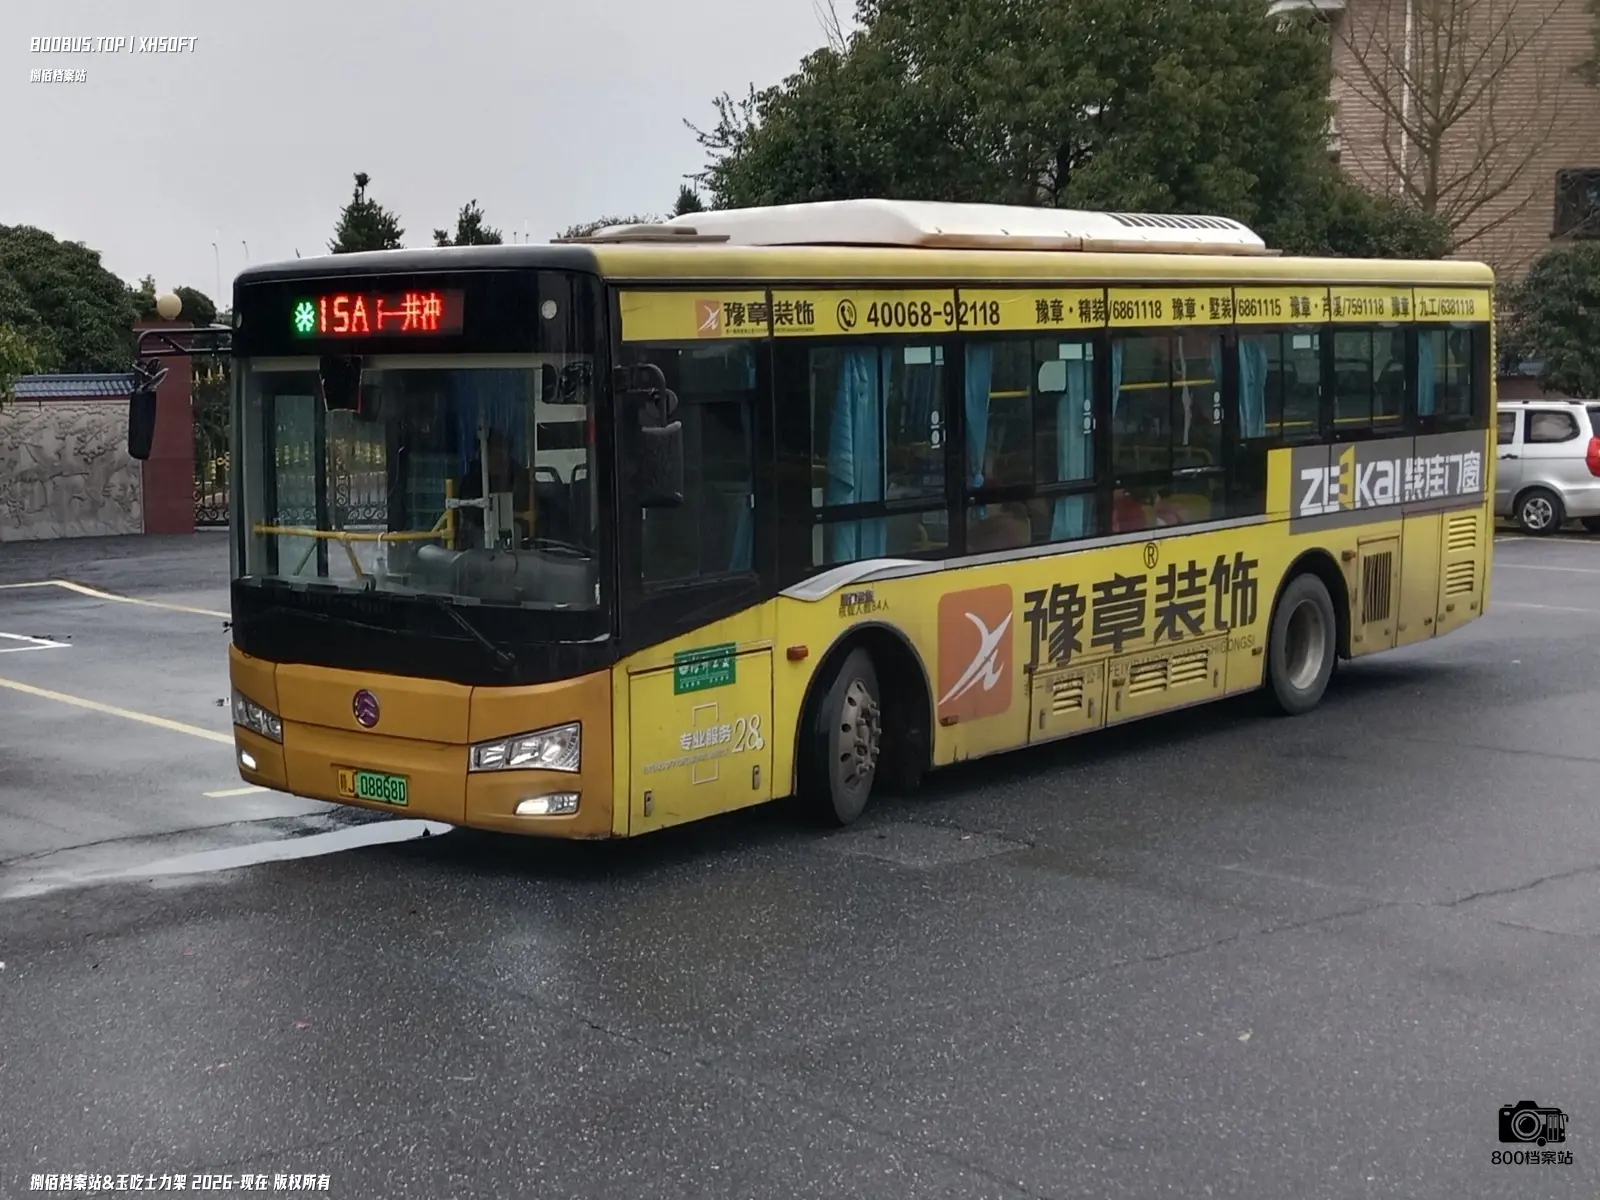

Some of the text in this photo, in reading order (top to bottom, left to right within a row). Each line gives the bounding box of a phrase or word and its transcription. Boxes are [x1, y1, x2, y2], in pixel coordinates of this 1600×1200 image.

[723, 299, 815, 327] 豫章装饰
[866, 299, 1001, 327] 40068-92118
[1023, 551, 1259, 674] 豫章装饰
[680, 724, 732, 751] 专业服务
